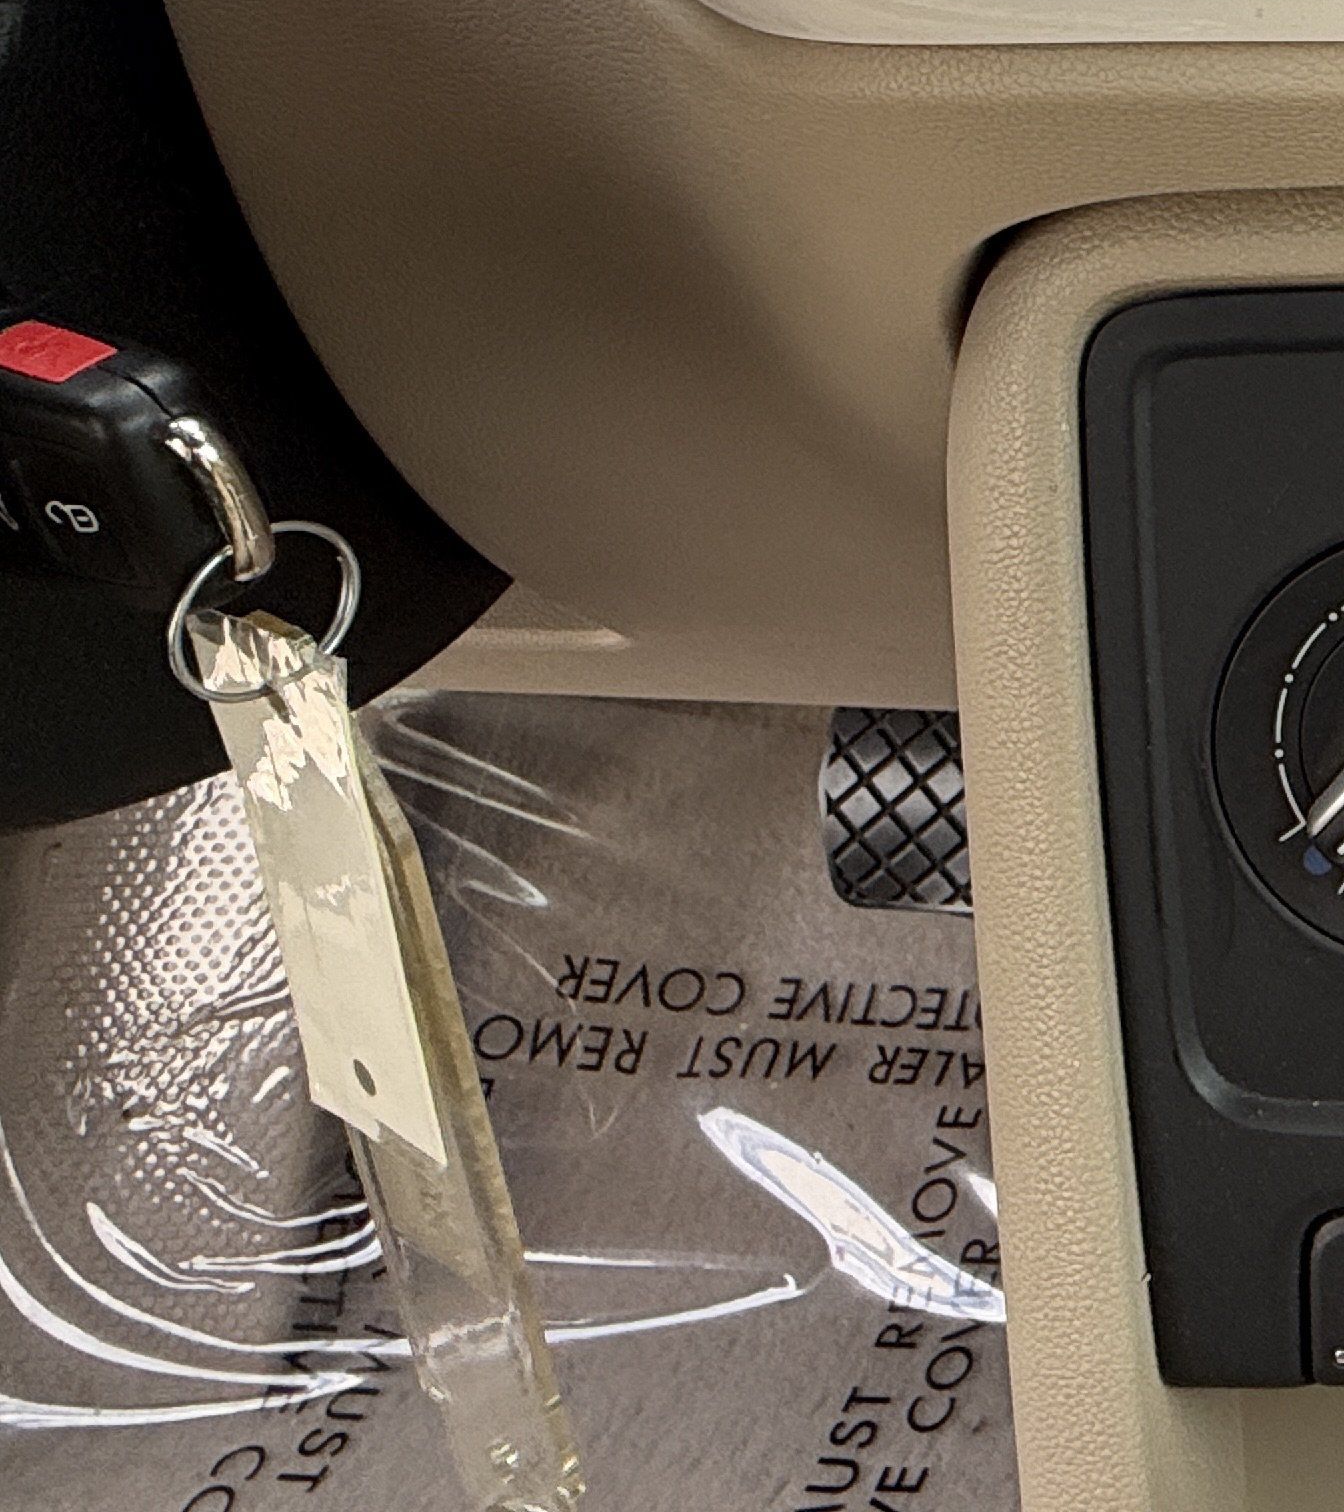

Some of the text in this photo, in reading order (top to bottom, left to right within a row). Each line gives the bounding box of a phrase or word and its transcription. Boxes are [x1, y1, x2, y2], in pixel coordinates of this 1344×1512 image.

[557, 953, 746, 1016] COVER
[473, 1013, 987, 1090] ALER MUST REMO
